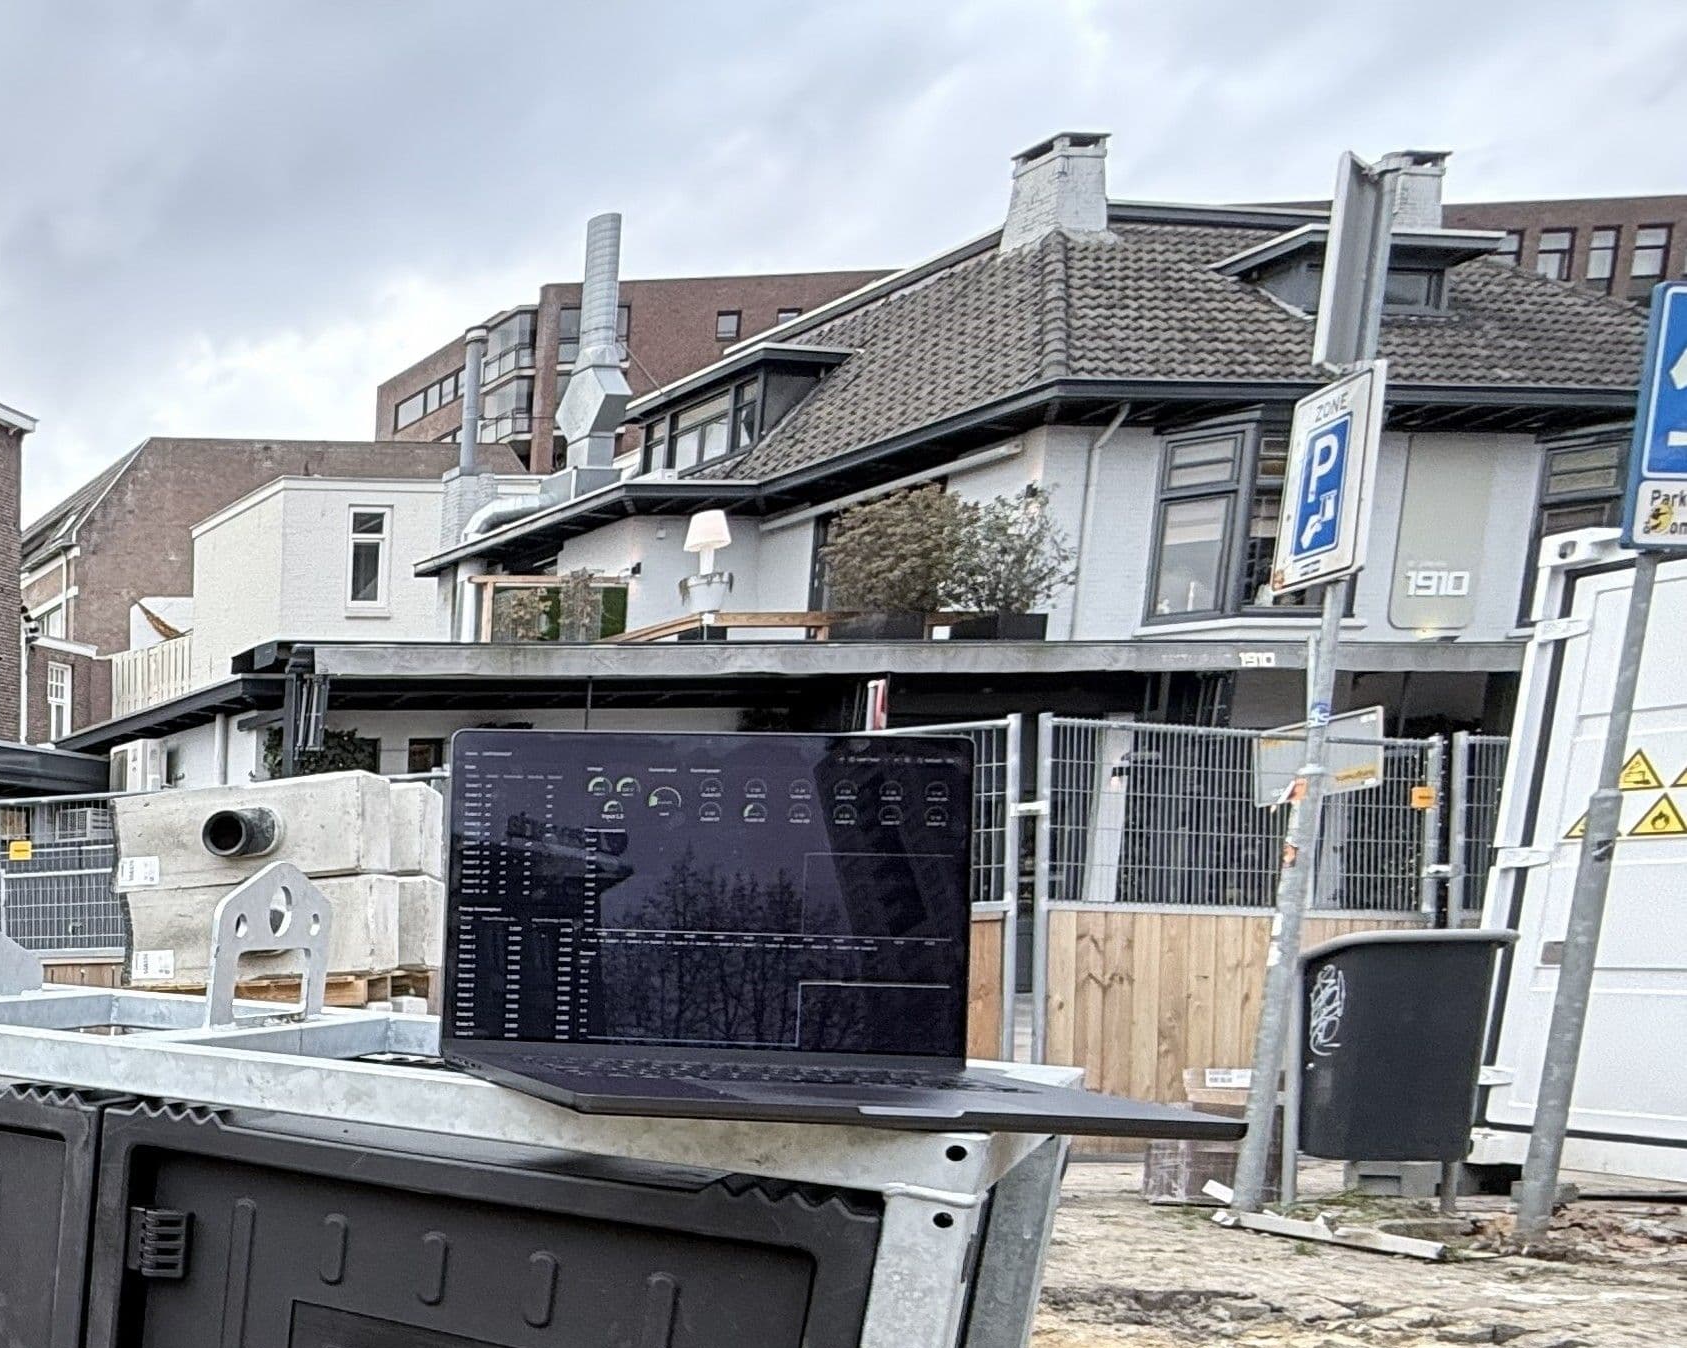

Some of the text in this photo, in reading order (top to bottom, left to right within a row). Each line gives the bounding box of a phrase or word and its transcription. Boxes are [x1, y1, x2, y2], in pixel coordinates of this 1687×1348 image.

[1315, 391, 1349, 423] ZONE
[1307, 433, 1339, 503] P
[1405, 571, 1470, 596] 1910
[1239, 652, 1275, 668] 1910
